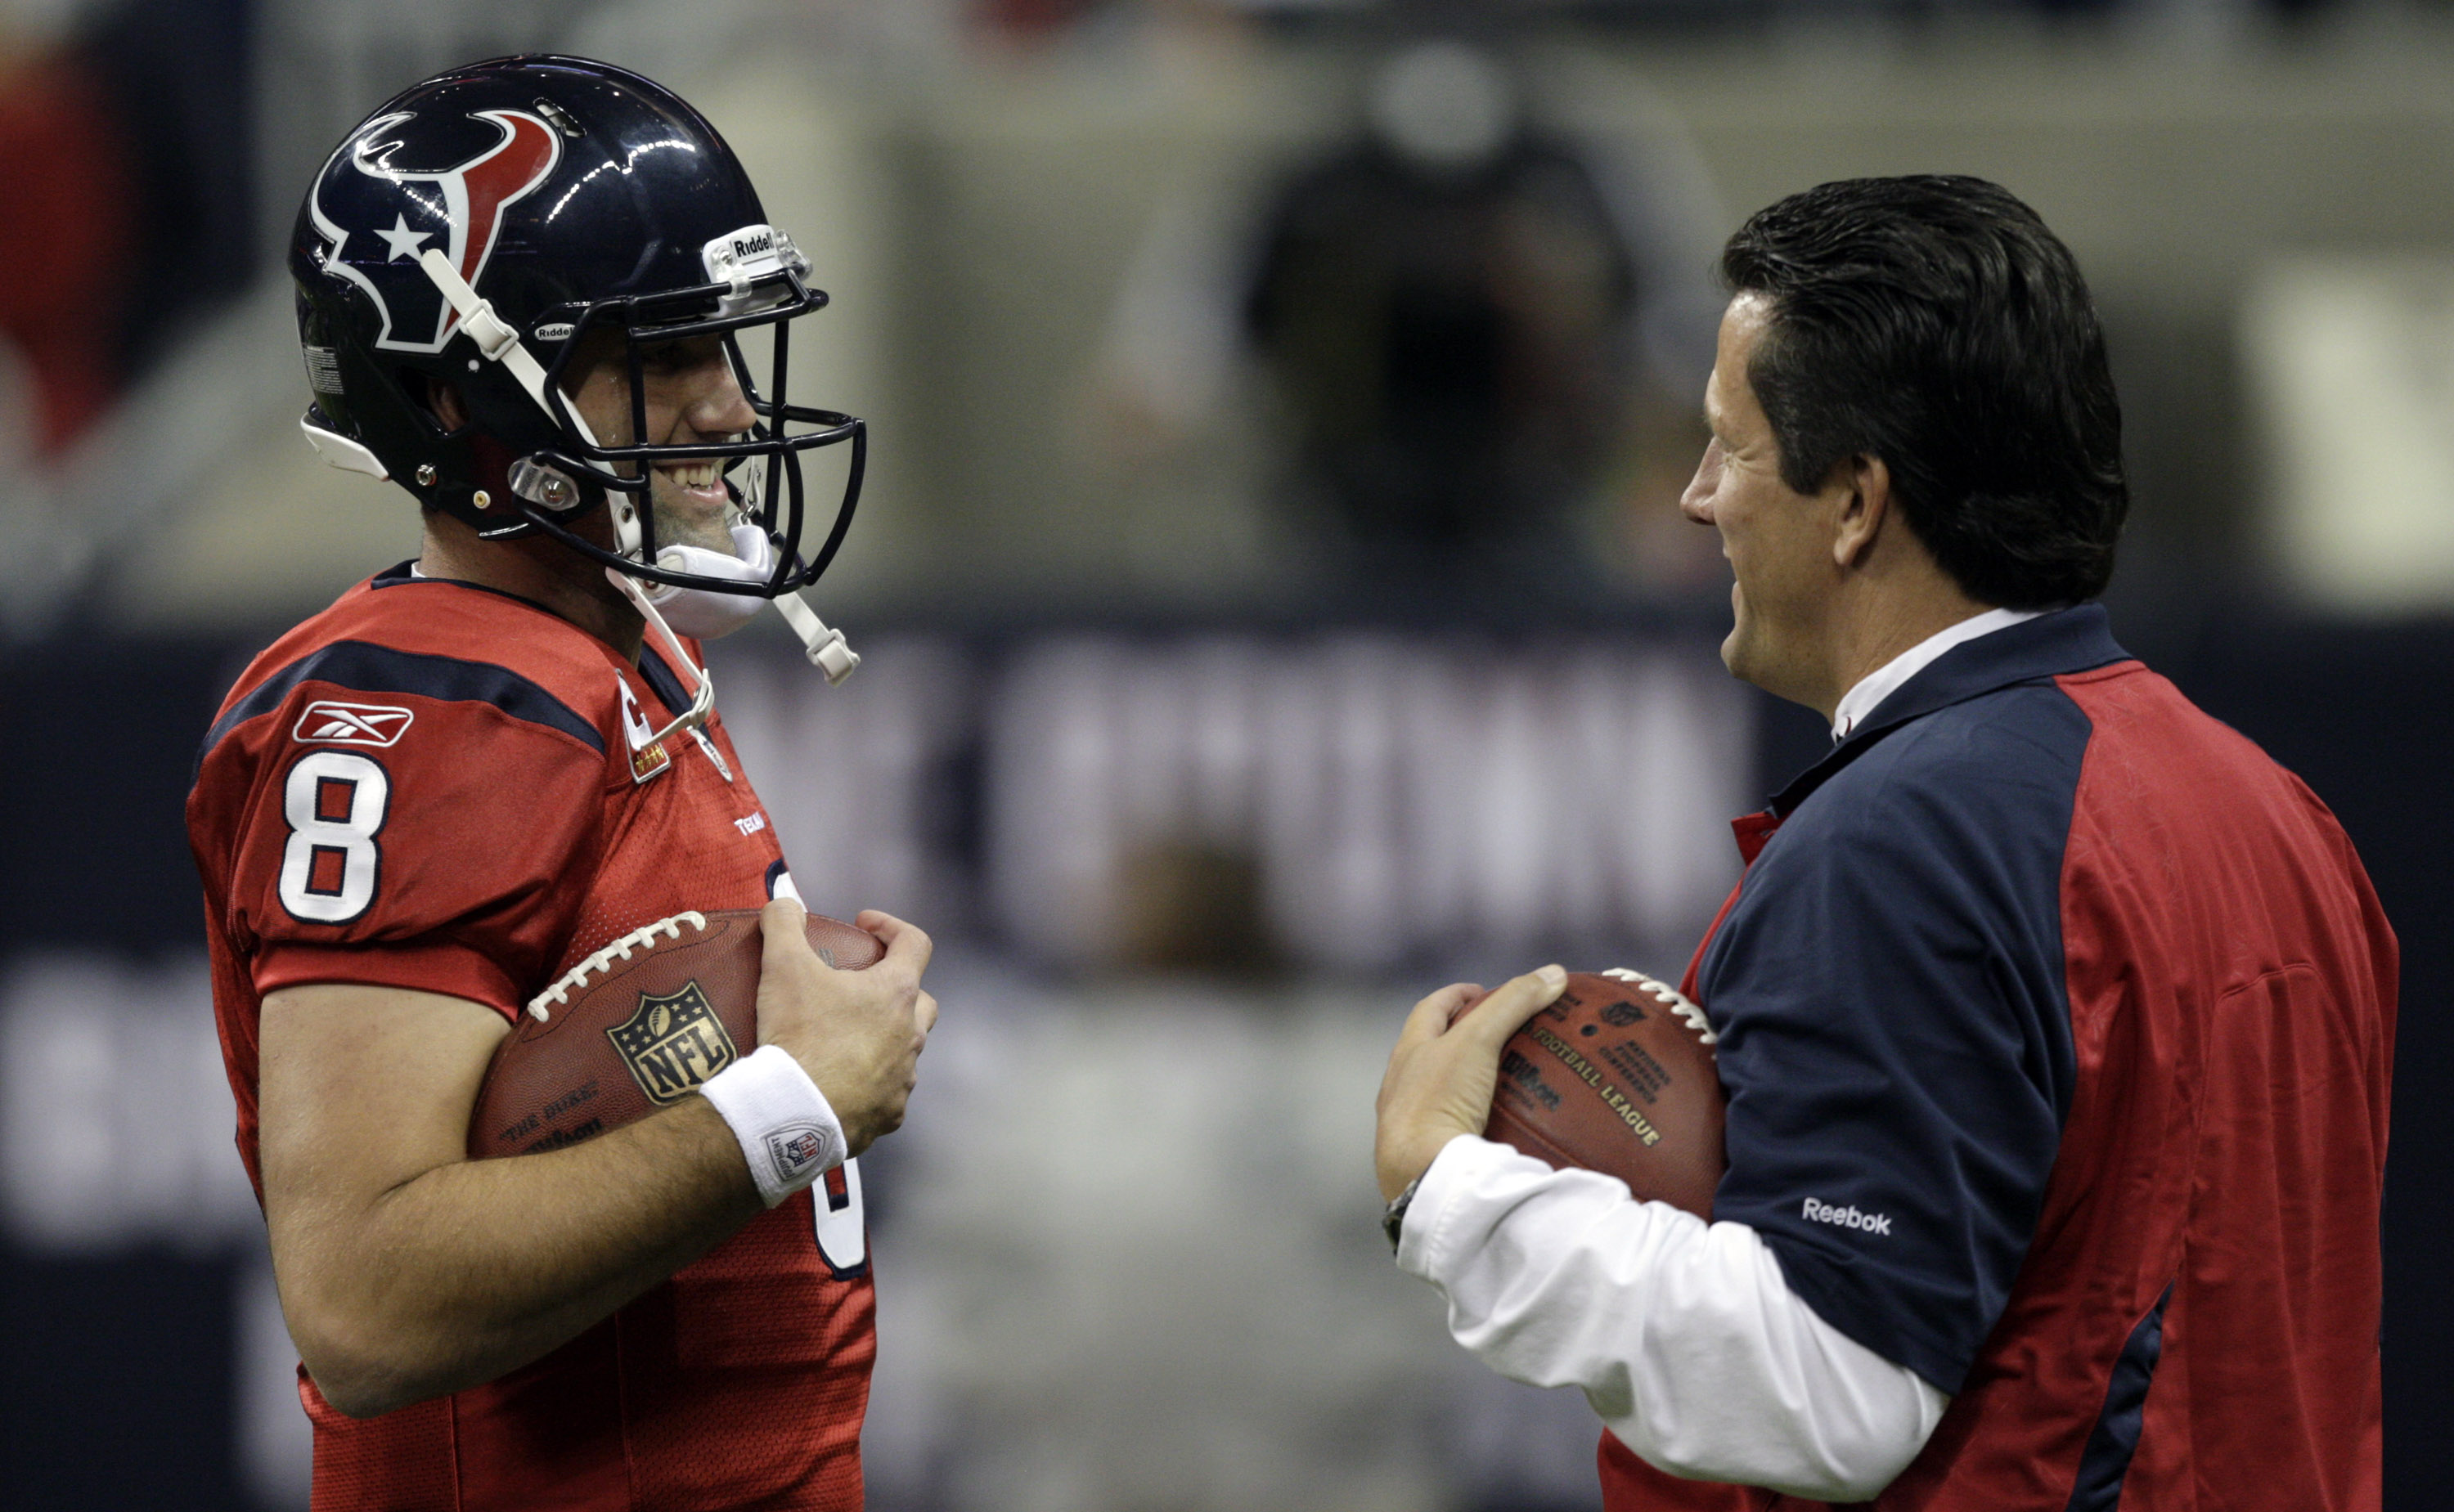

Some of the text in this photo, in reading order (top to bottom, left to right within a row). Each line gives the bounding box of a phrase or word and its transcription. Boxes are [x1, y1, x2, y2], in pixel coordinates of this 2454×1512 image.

[734, 231, 775, 258] Riddell
[539, 327, 573, 337] Riddel
[278, 749, 391, 925] 8
[639, 1025, 727, 1094] NFL
[1532, 1029, 1602, 1088] FOOTBALL
[1600, 1084, 1661, 1146] LEAGUE
[799, 1134, 818, 1160] NFL
[1801, 1196, 1892, 1236] Reebok
